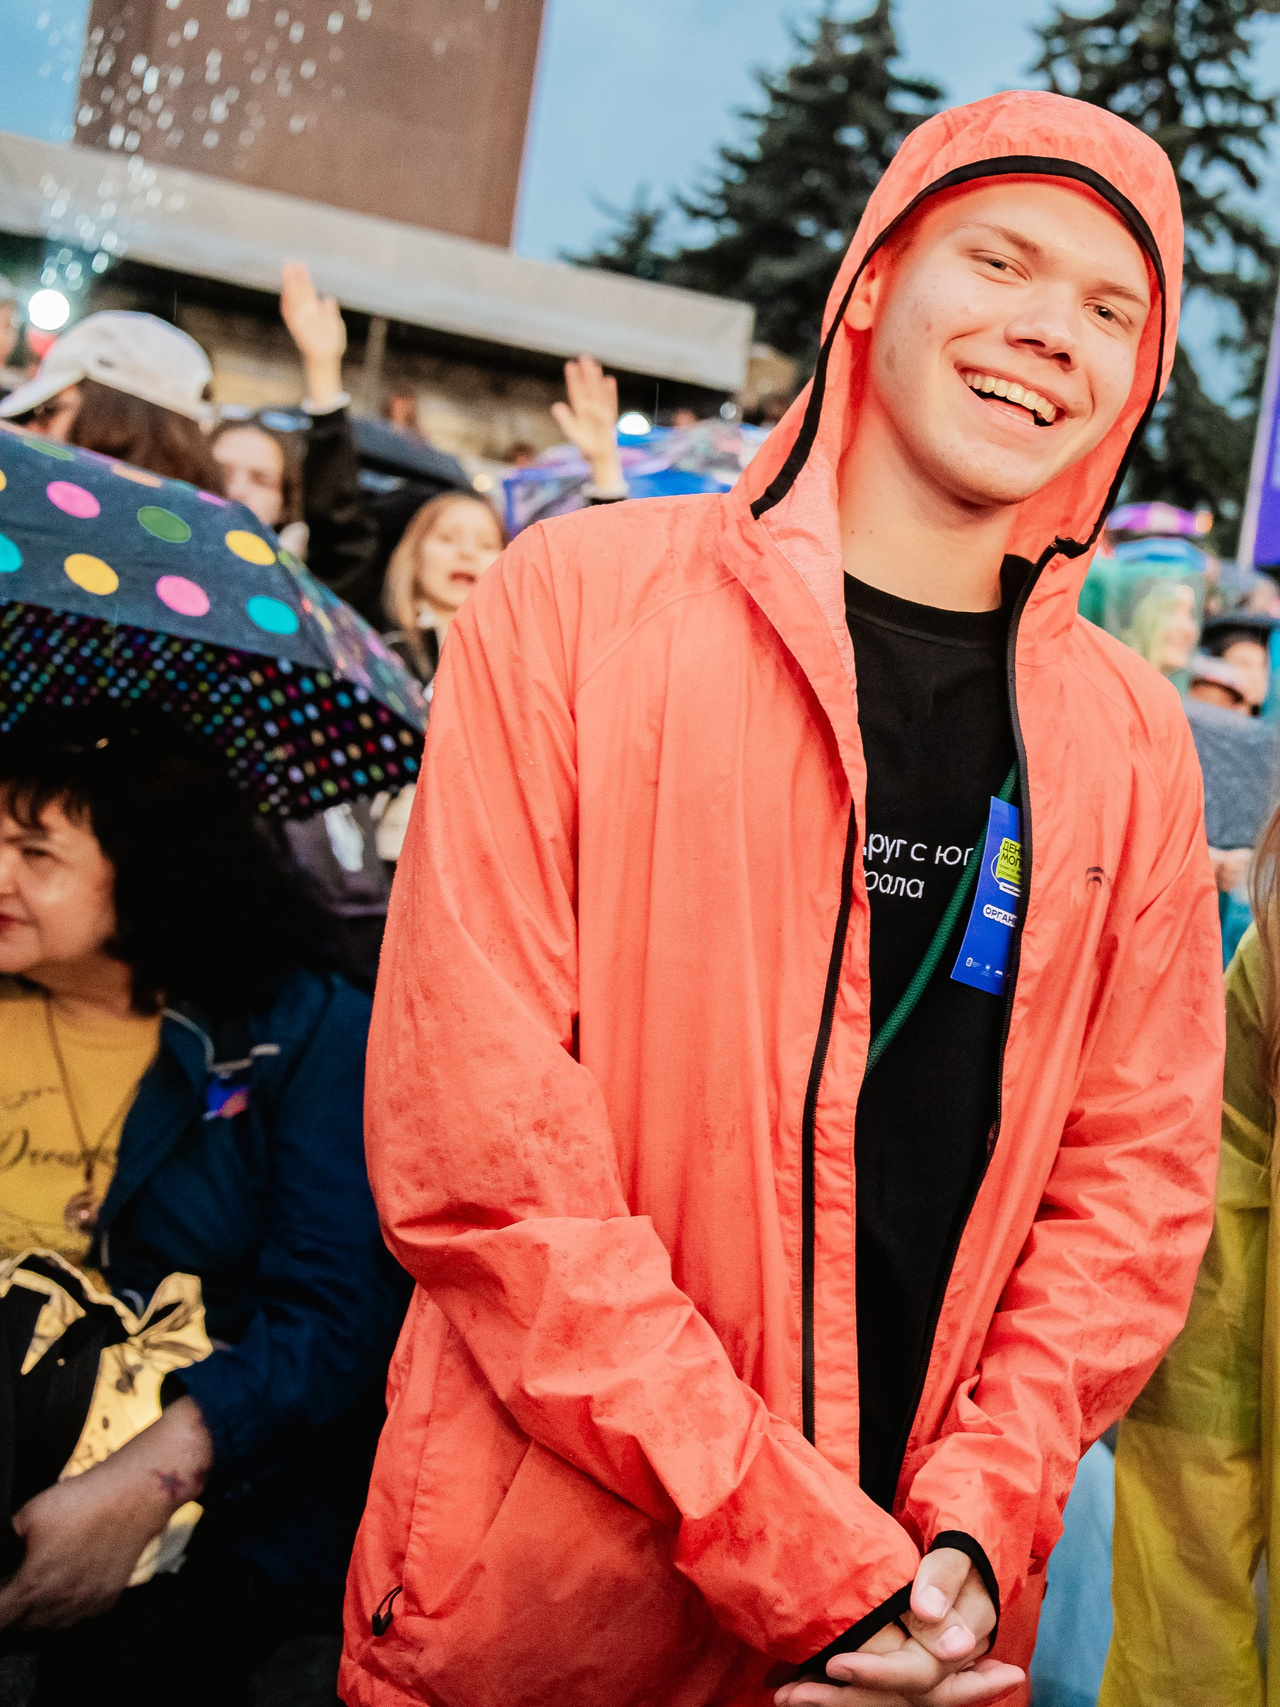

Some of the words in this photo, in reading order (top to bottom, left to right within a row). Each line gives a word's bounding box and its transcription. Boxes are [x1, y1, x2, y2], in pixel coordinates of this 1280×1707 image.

[862, 833, 908, 864] руг
[910, 843, 928, 862] с
[934, 845, 975, 866] юг
[1002, 841, 1021, 854] ДЕН
[863, 870, 925, 899] рала
[985, 906, 1016, 925] ОРГАН
